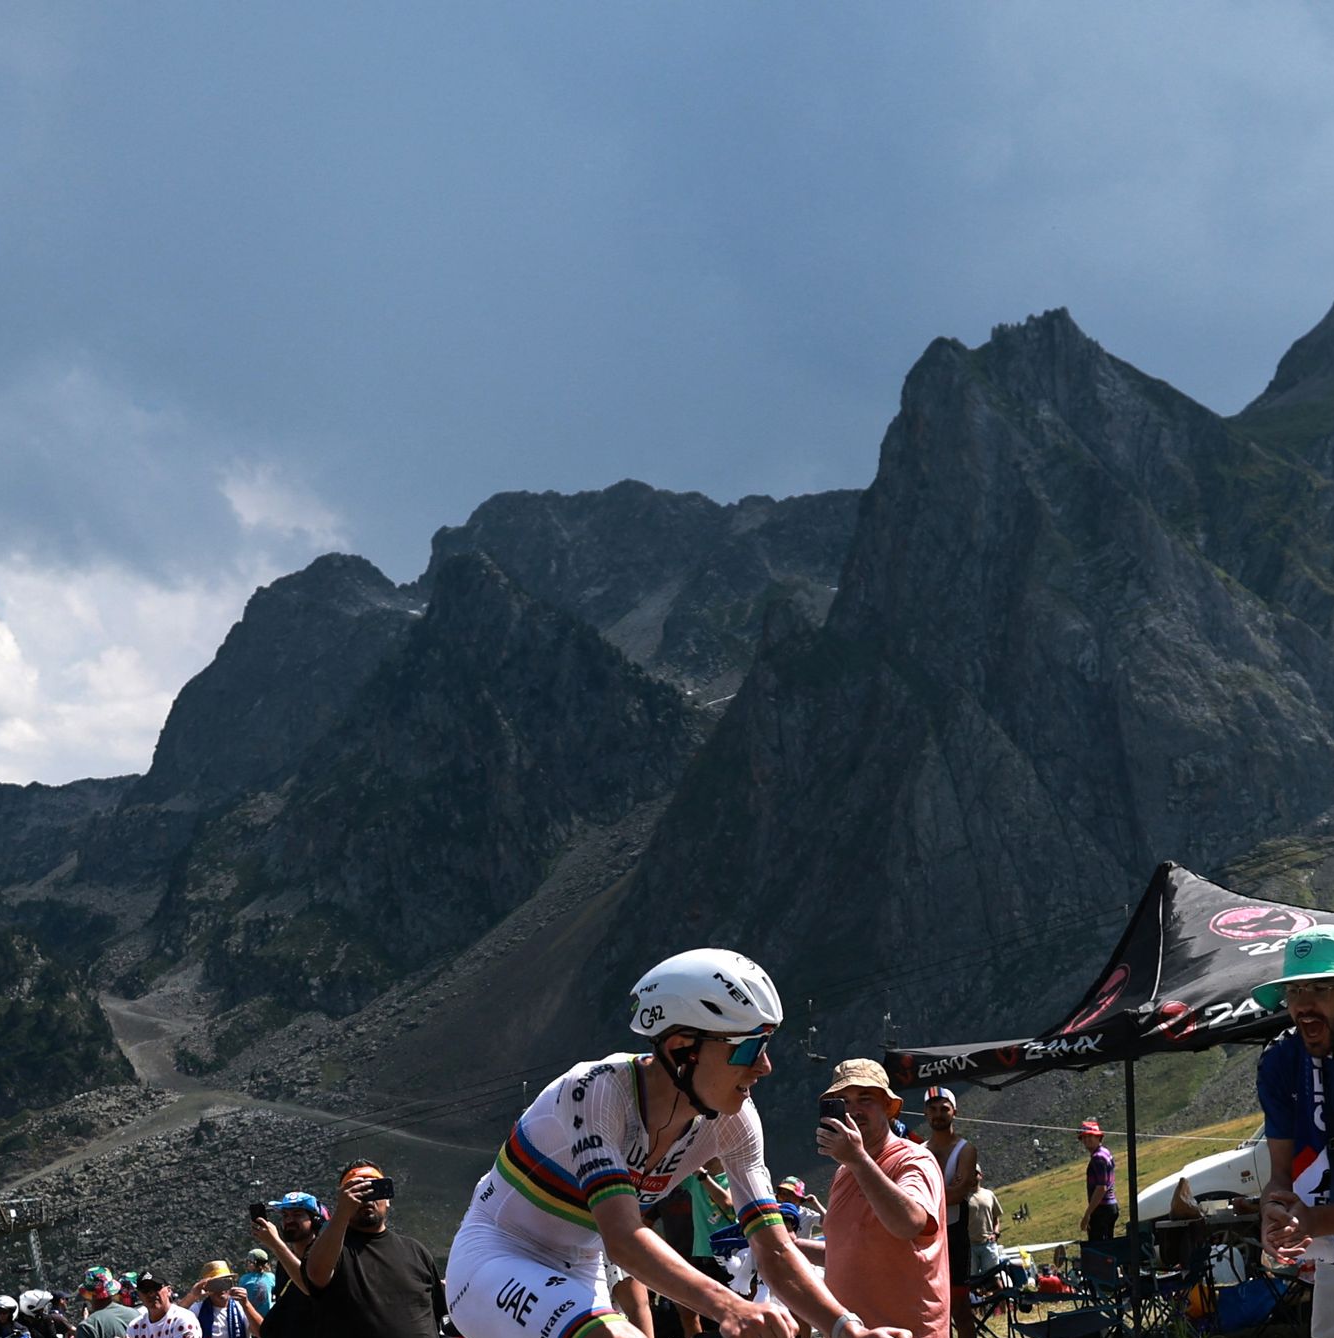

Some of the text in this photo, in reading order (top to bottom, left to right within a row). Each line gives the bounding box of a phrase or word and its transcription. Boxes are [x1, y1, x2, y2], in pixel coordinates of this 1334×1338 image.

[713, 972, 754, 1007] MET
[639, 1004, 666, 1030] G42
[496, 1277, 540, 1328] UAE
